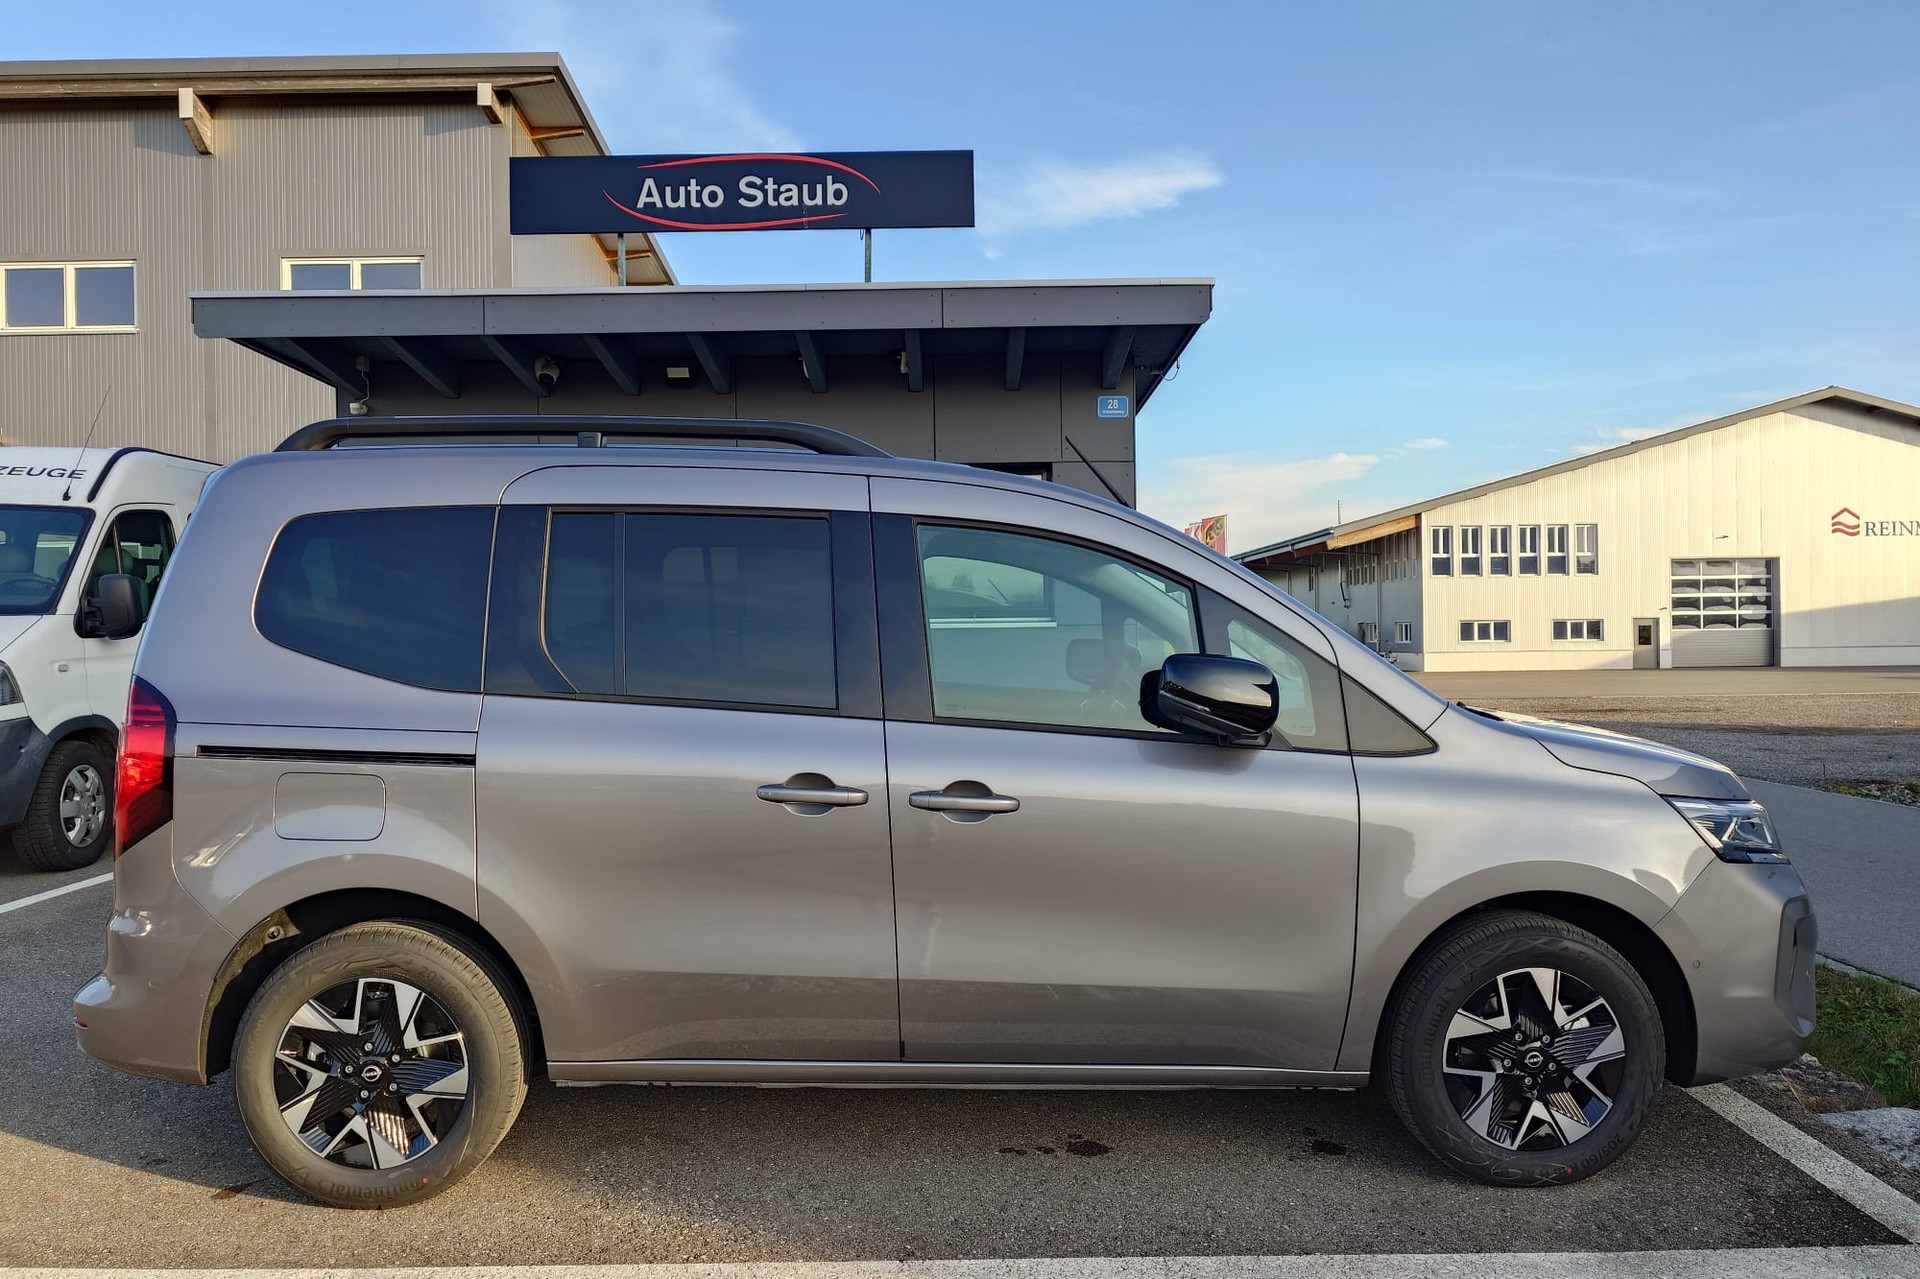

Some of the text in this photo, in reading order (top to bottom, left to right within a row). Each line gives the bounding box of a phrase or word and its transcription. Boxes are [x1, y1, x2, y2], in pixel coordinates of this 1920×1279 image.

[636, 176, 848, 209] Auto Staub
[1107, 399, 1119, 409] 28
[1865, 521, 1920, 537] REIN
[1580, 1133, 1625, 1170] 205/60
